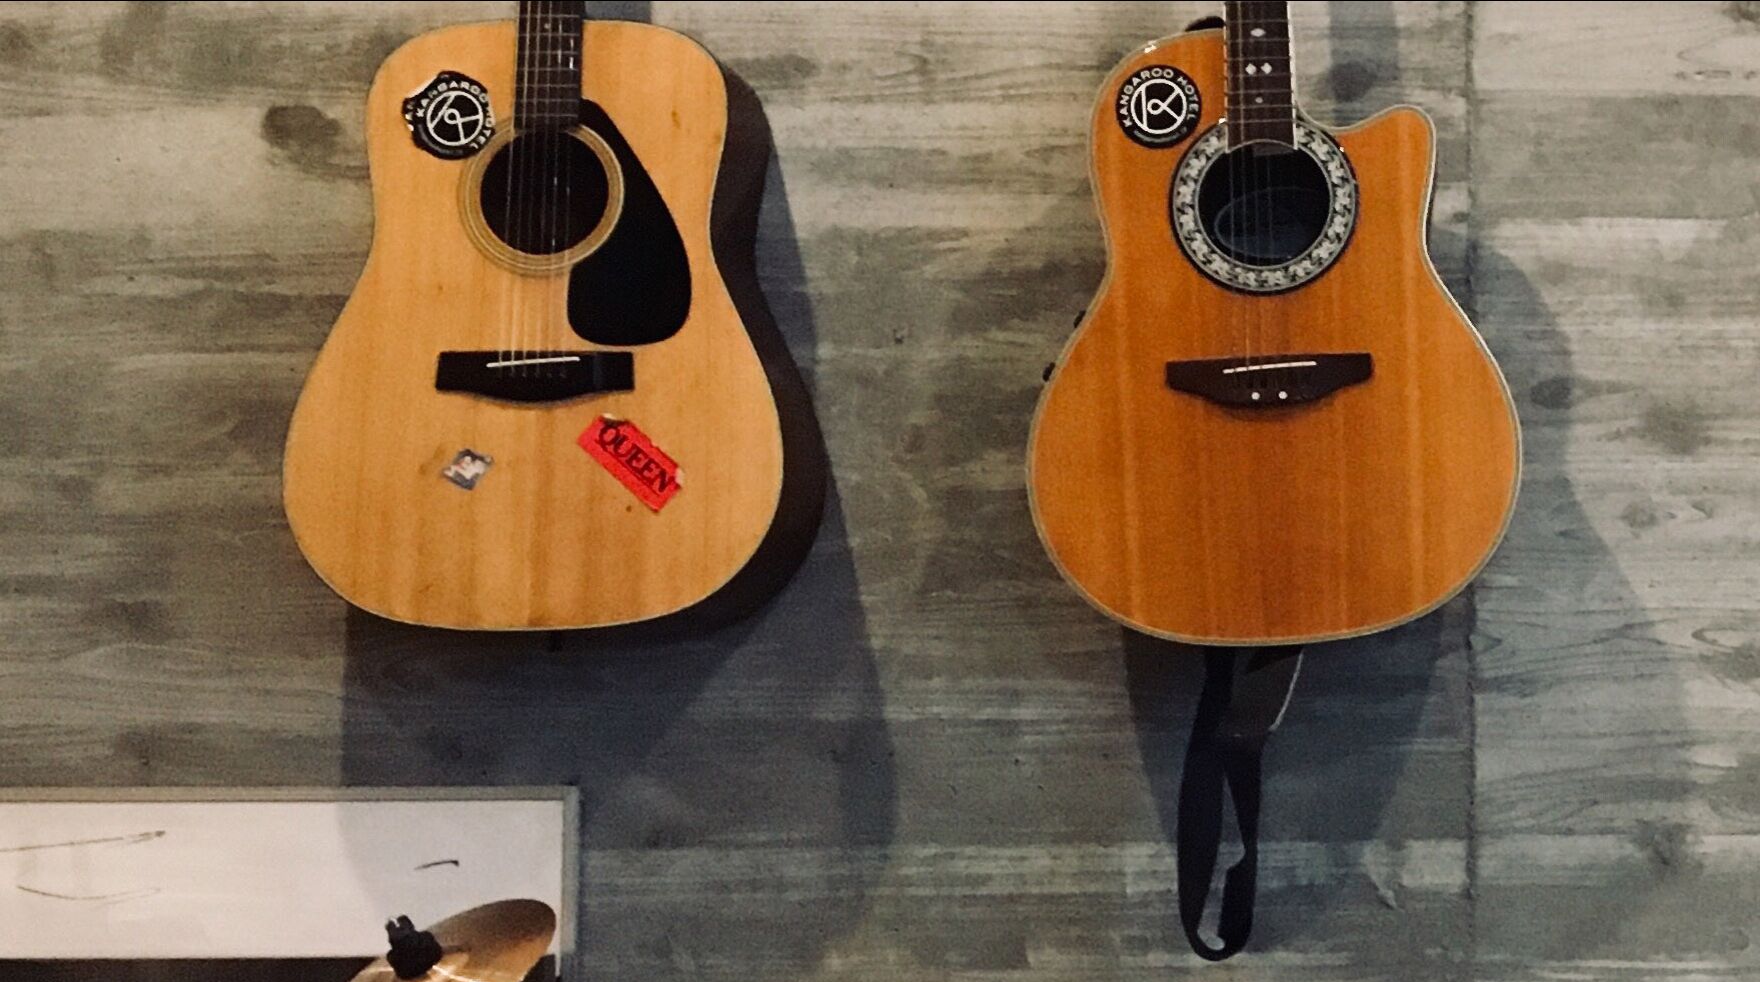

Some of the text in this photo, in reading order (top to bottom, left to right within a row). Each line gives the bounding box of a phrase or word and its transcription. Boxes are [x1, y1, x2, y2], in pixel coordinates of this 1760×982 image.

[1120, 68, 1199, 127] KANGAROO HOTEL
[595, 424, 676, 493] QUEEN
